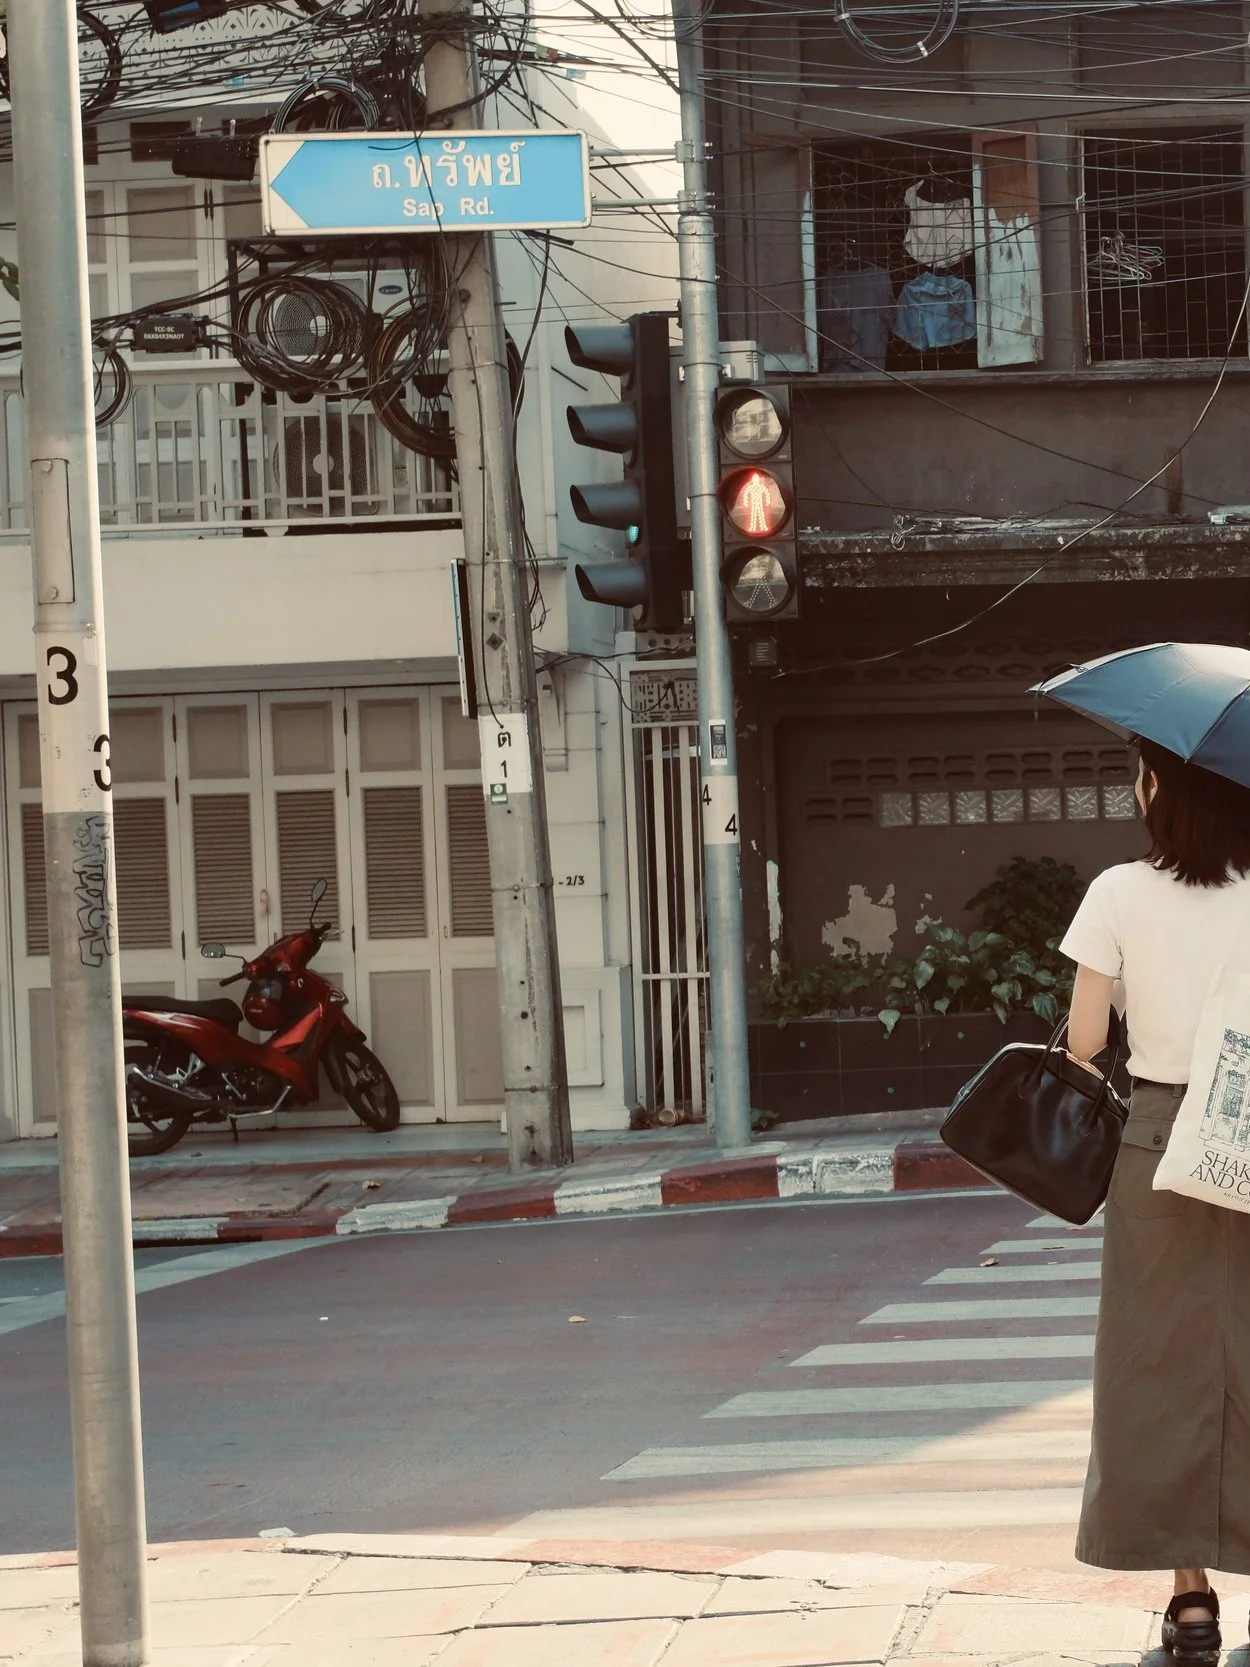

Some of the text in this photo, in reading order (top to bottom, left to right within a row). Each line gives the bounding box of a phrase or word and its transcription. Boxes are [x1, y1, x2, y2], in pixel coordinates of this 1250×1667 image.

[371, 140, 526, 189] ถ.ทรัพย์
[403, 197, 494, 221] Sap Rd.
[46, 646, 79, 705] 3
[500, 760, 508, 778] 1
[702, 783, 712, 806] 4
[724, 813, 738, 836] 4
[1189, 1164, 1235, 1190] AND
